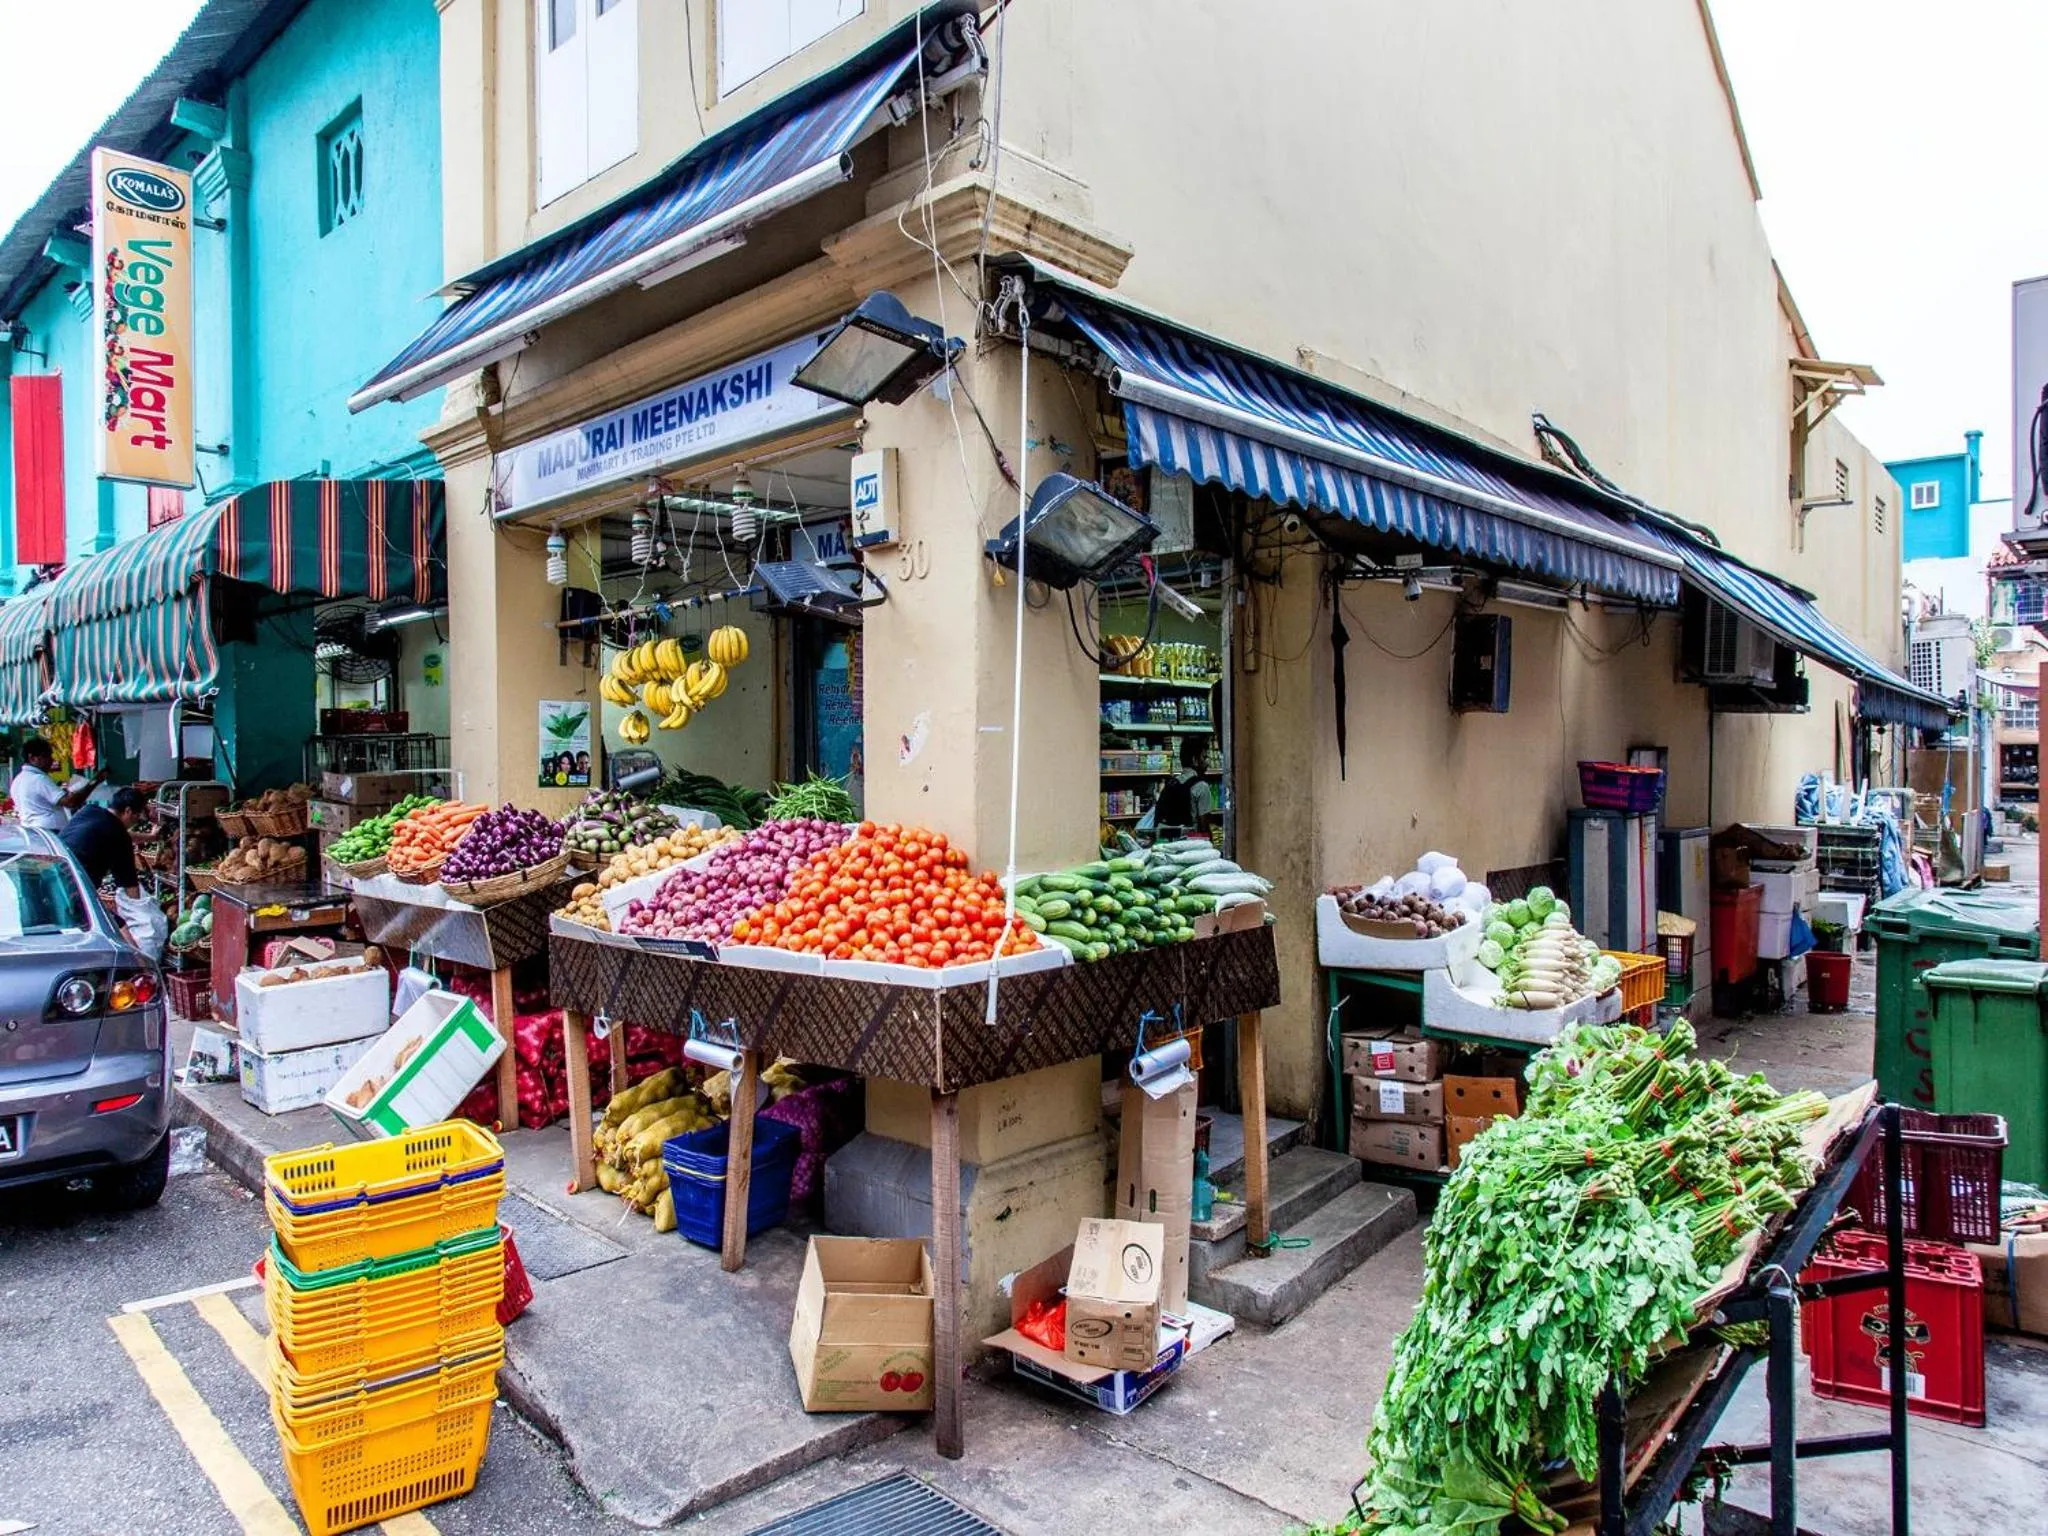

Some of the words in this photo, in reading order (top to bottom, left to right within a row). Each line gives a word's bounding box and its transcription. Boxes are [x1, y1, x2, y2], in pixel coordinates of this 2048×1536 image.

[116, 175, 175, 200] KOMALA'S
[114, 240, 172, 336] Vege
[129, 347, 174, 450] Mart
[538, 418, 625, 478] MADURAI
[632, 361, 772, 443] MEENAKSHI
[631, 437, 672, 462] TRADING
[675, 428, 695, 448] PTE
[696, 421, 716, 440] LTD
[856, 478, 878, 502] ADT
